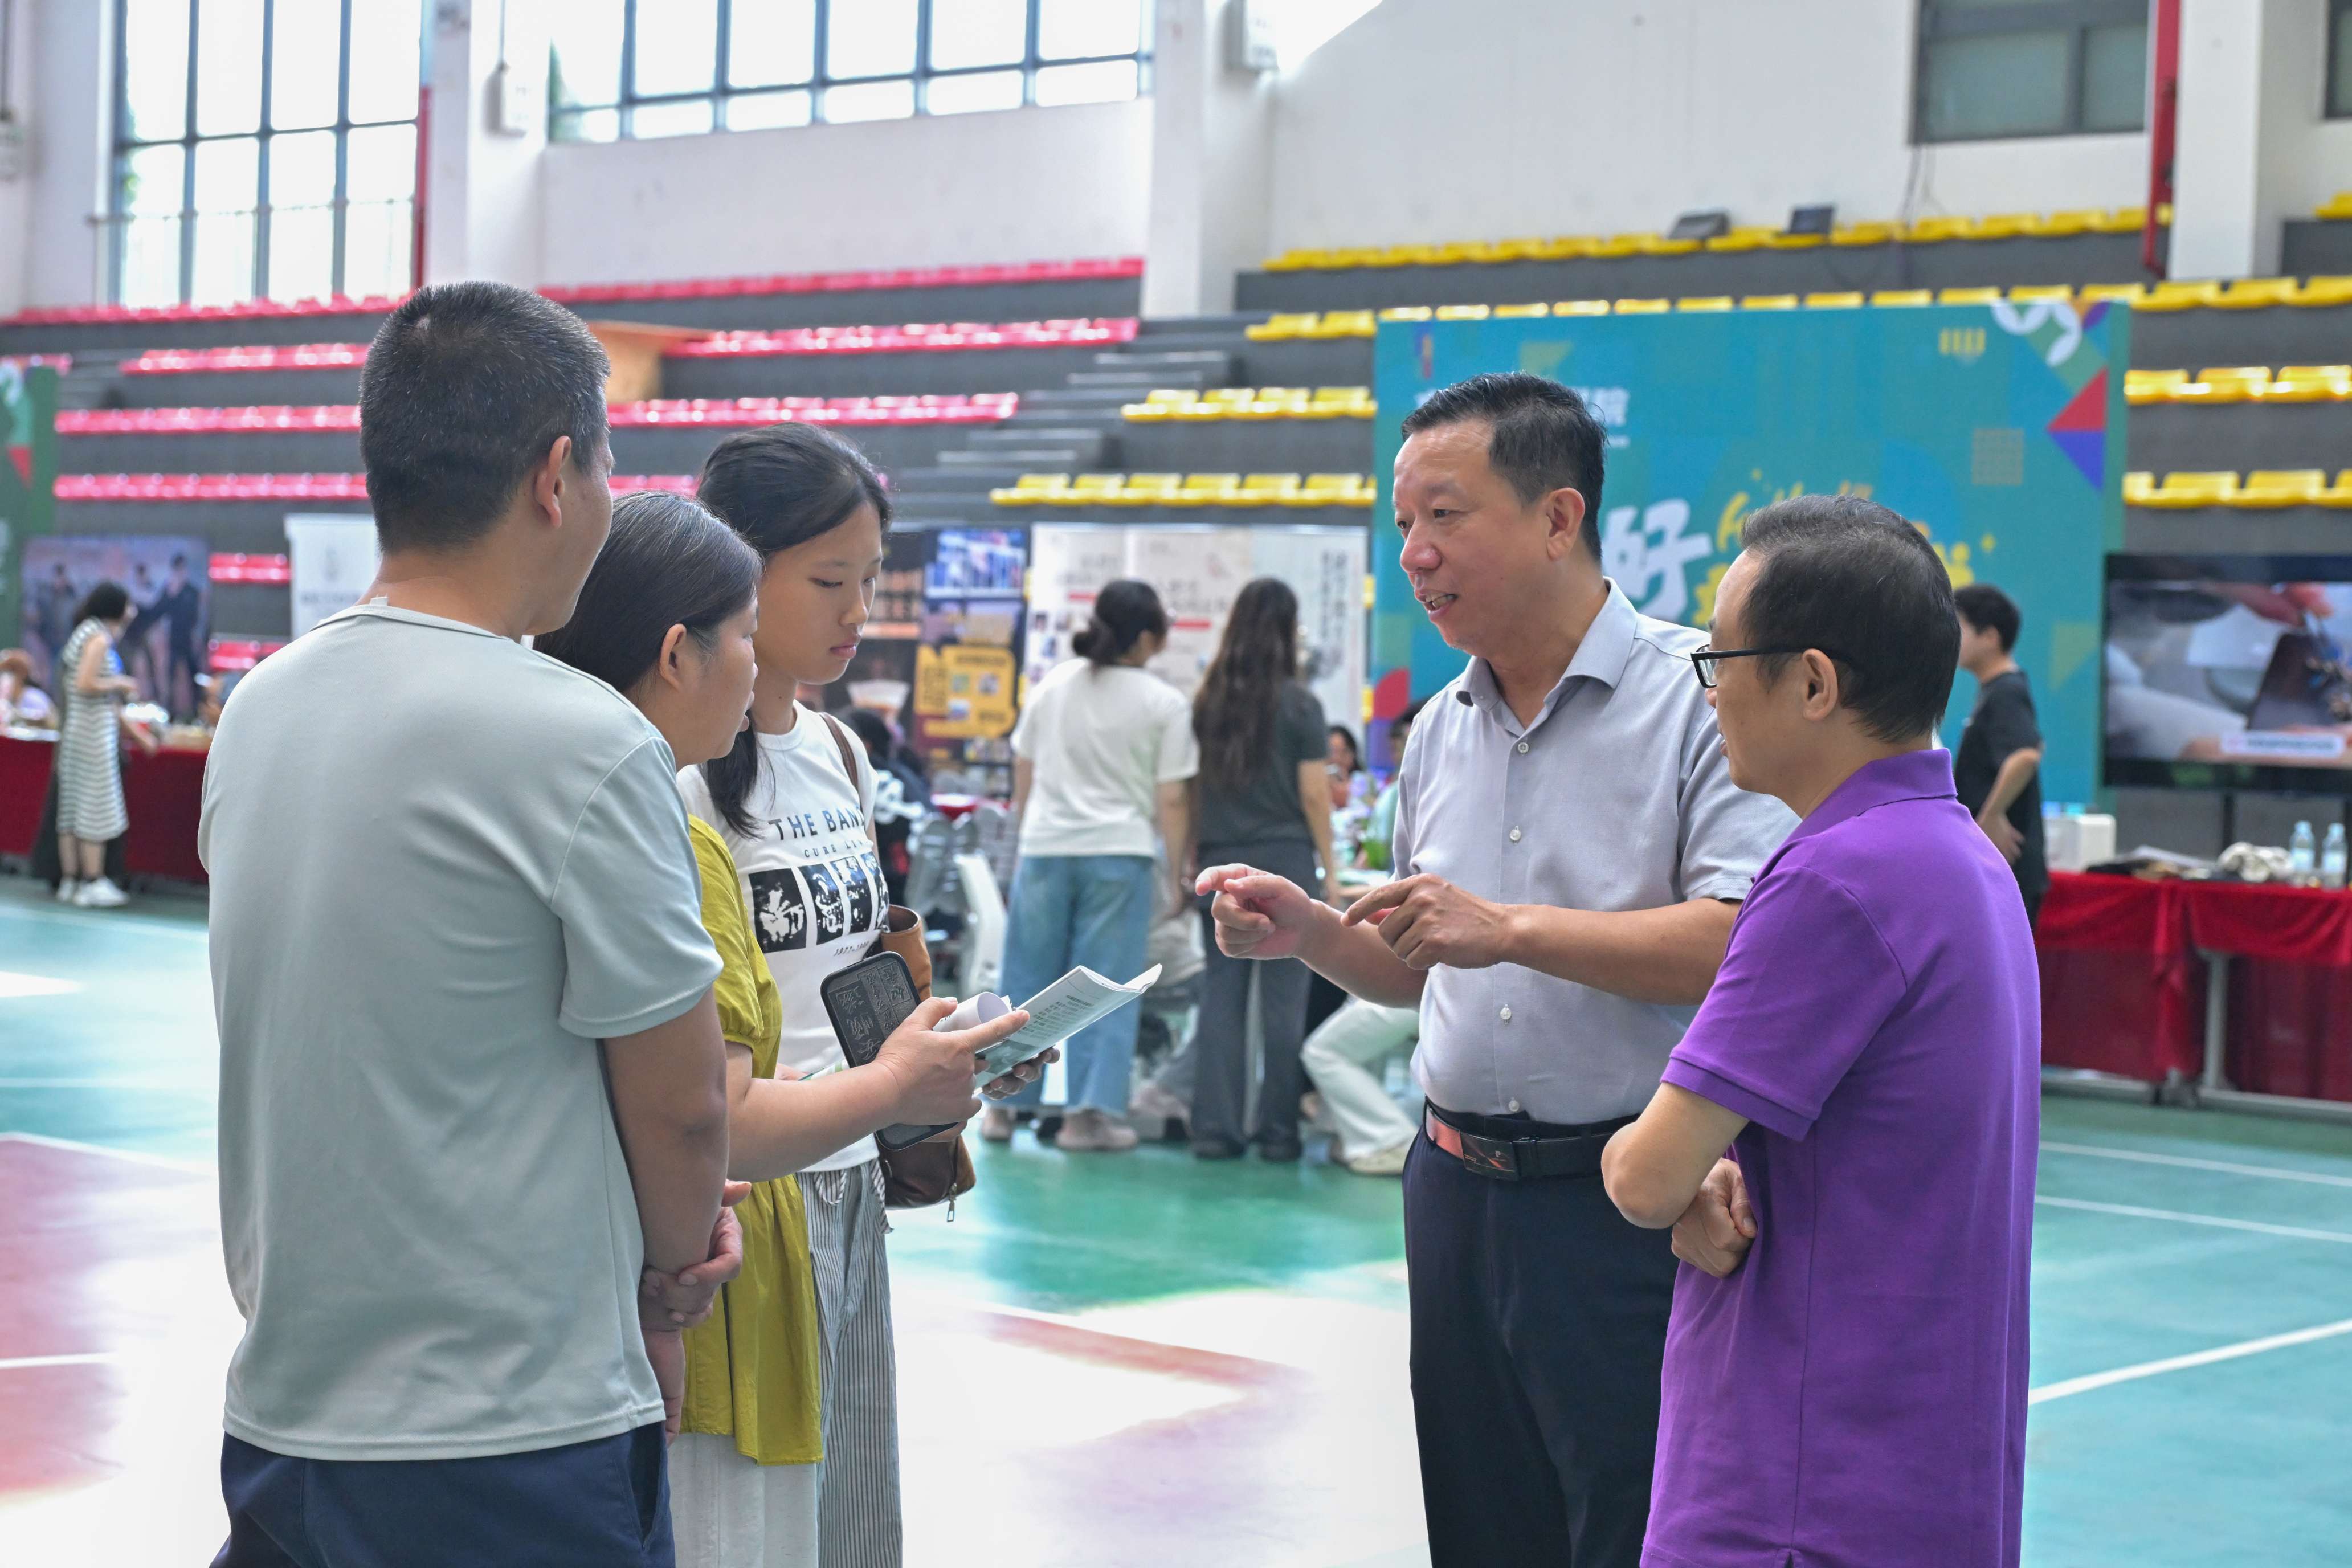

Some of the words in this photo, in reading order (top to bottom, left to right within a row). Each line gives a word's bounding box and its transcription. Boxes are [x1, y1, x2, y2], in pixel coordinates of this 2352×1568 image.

[1601, 497, 1712, 622] 好
[767, 813, 818, 840] THE
[822, 805, 865, 832] BAN
[804, 844, 837, 858] CURE
